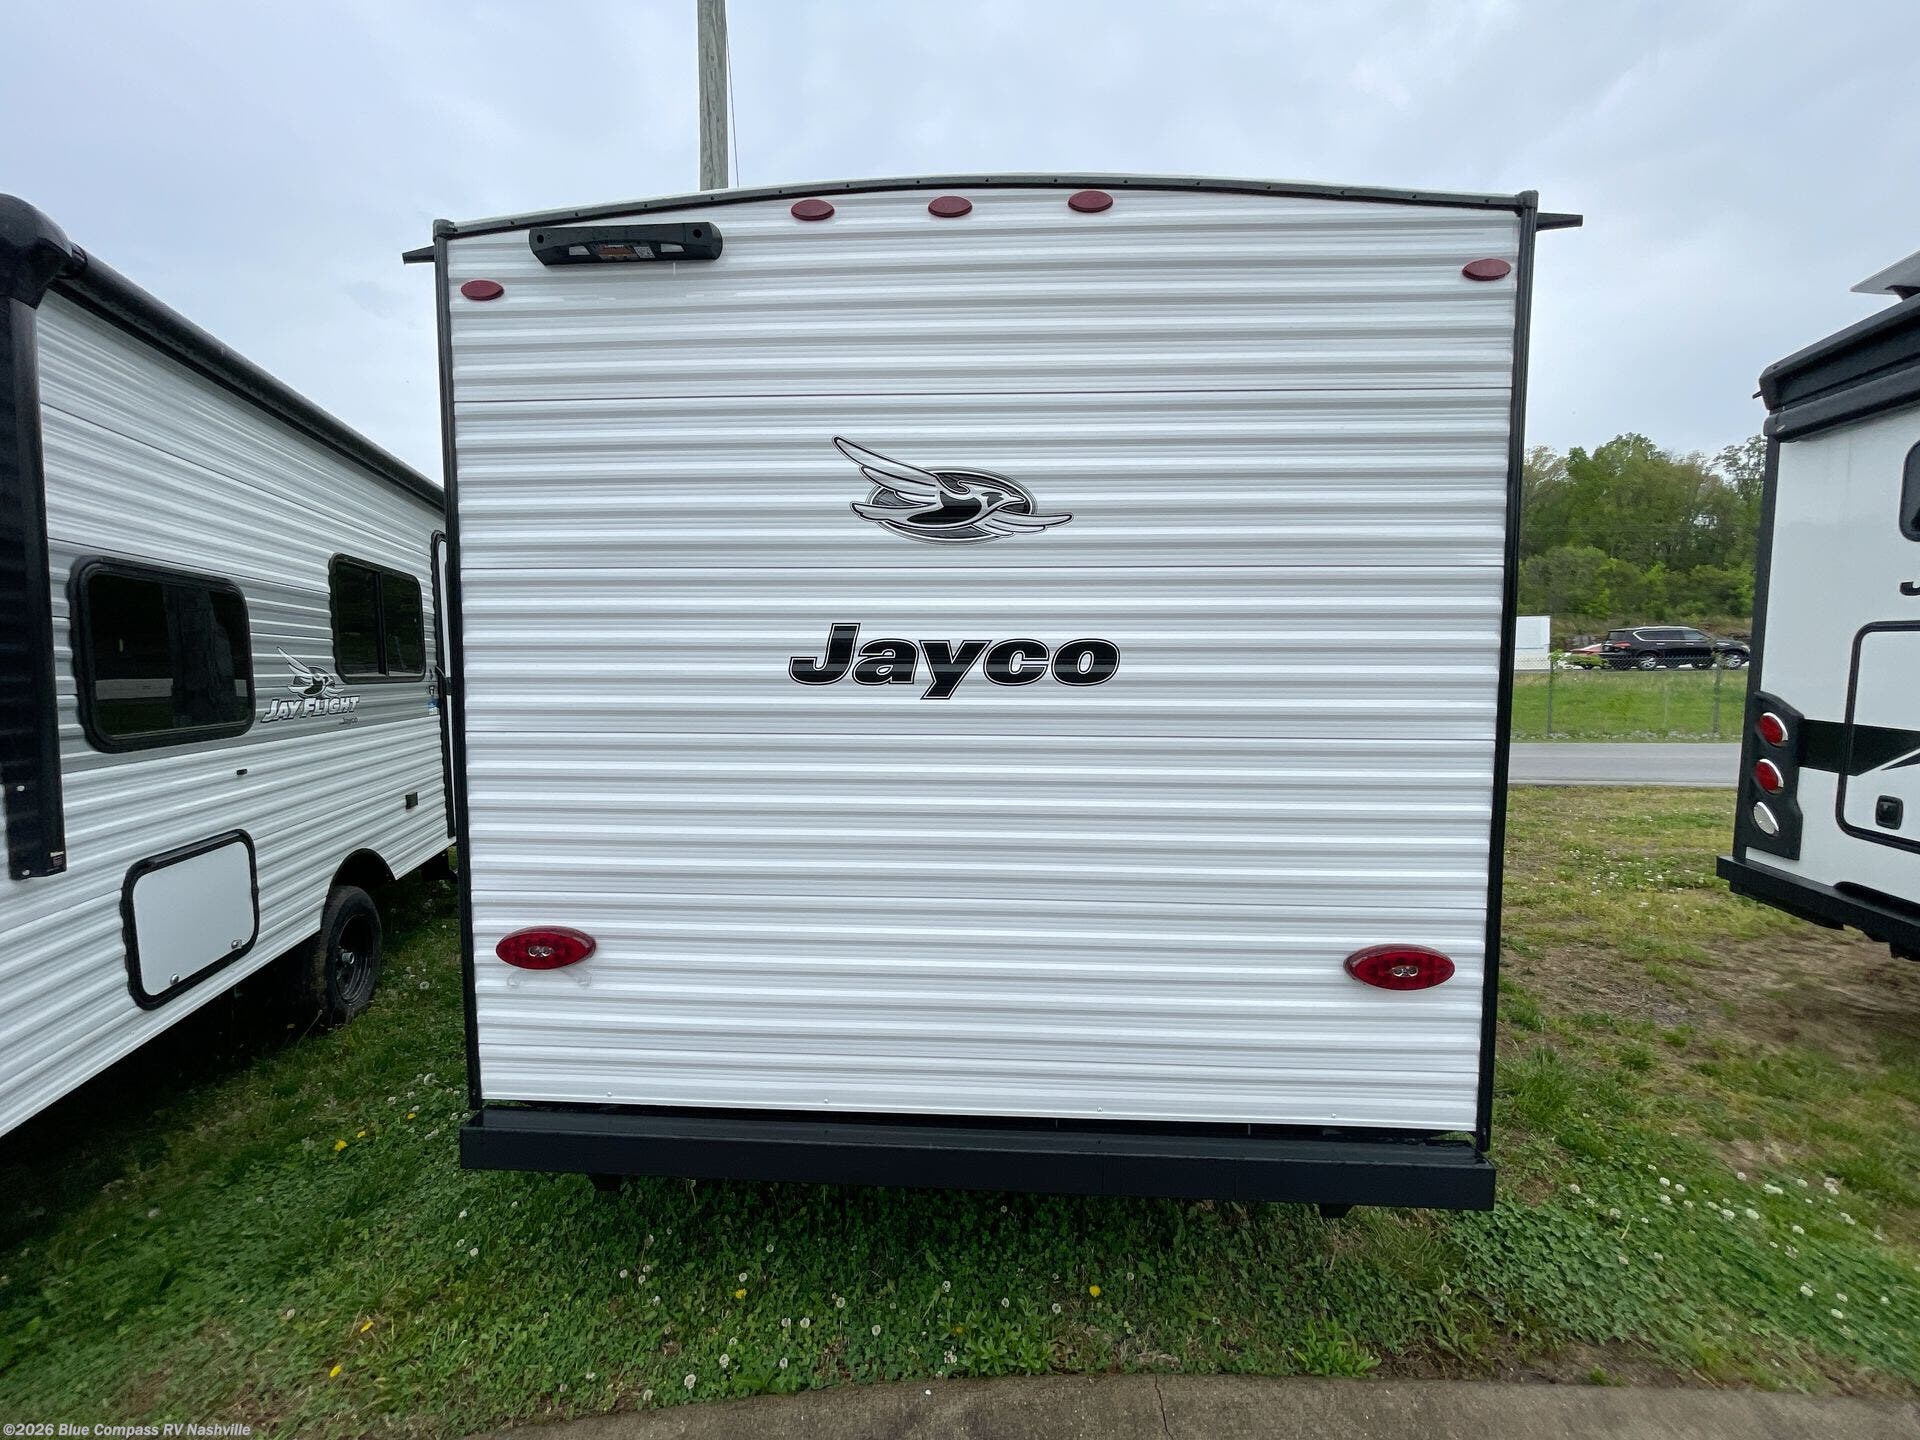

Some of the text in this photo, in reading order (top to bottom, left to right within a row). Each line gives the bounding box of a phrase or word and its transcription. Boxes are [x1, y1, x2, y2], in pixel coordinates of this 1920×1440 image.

[789, 622, 1120, 700] Jayco
[260, 695, 361, 724] JAY FLIGHT
